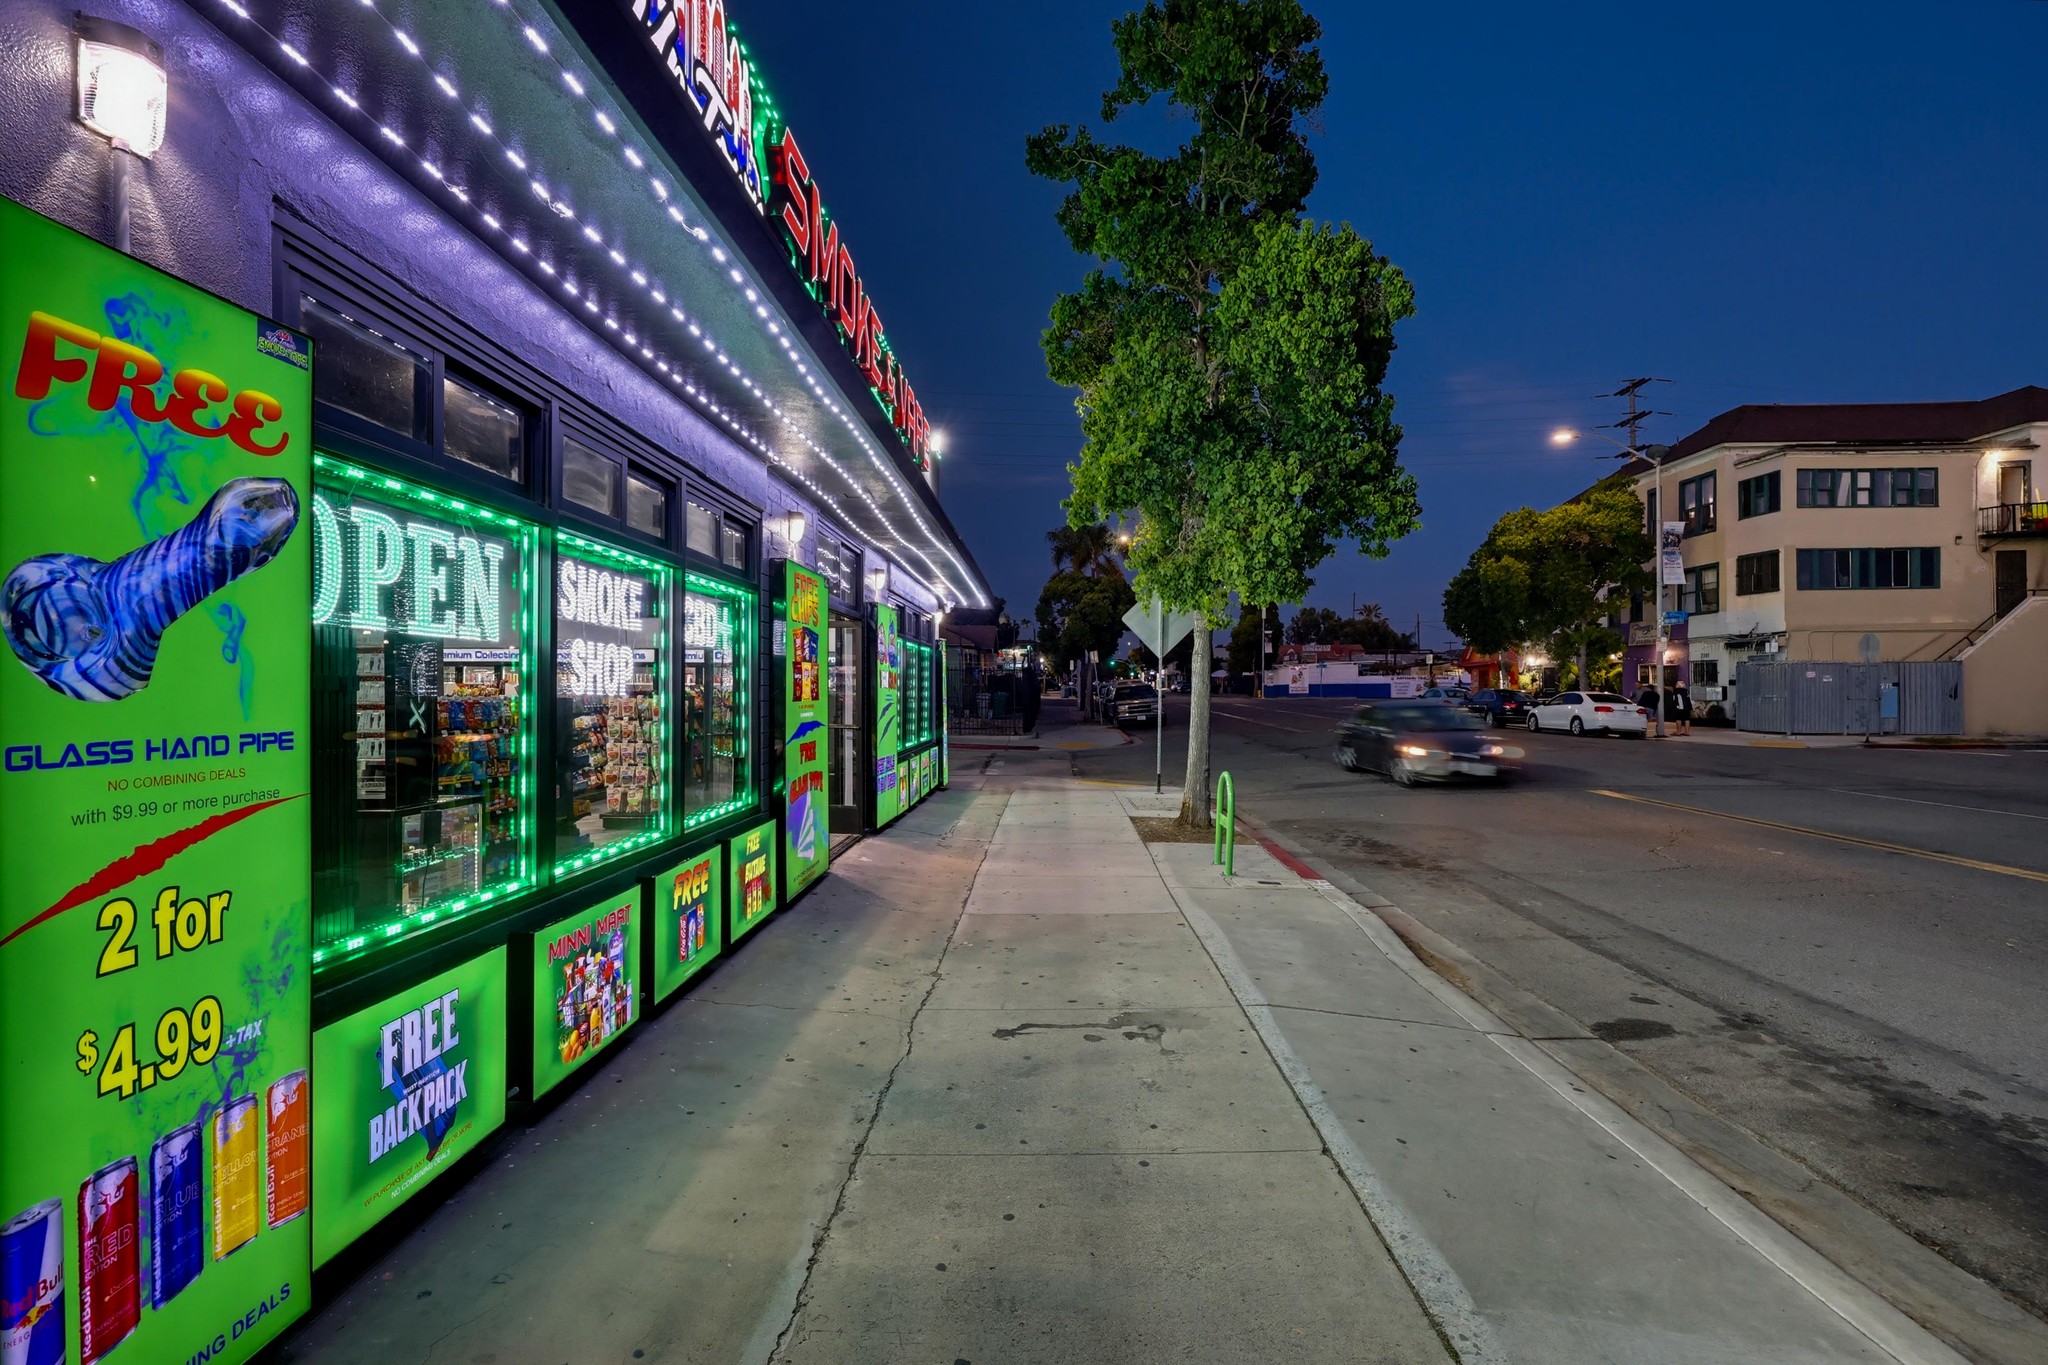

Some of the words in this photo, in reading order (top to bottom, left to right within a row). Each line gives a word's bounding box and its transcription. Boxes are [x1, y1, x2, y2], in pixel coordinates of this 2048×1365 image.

[783, 127, 883, 387] SMOKE
[885, 351, 898, 408] &
[898, 363, 931, 472] VAPE
[15, 311, 289, 456] FREE
[560, 561, 643, 631] SMOKE
[794, 571, 818, 601] FREE
[791, 595, 819, 627] CHIPS
[443, 650, 472, 659] emium
[571, 638, 634, 695] SHOP
[5, 739, 134, 772] GLASS
[145, 734, 230, 762] HAND
[239, 731, 295, 754] PIPE
[107, 779, 129, 792] NO
[132, 771, 206, 789] COMBINING
[209, 767, 246, 781] DEALS
[71, 808, 107, 826] with
[112, 801, 158, 822] $9.99
[162, 801, 178, 814] or
[182, 796, 218, 811] more
[222, 788, 281, 807] purchase
[673, 858, 711, 911] FREE
[95, 897, 139, 978] 2
[152, 886, 233, 960] for
[596, 903, 633, 942] MART
[76, 995, 224, 1101] $4.99
[380, 987, 460, 1091] FREE
[268, 1123, 310, 1151] RANG
[217, 1150, 258, 1181] ELLO
[84, 1223, 135, 1272] RED
[37, 1261, 64, 1301] Bull
[81, 1285, 92, 1320] Bull
[232, 1282, 291, 1341] DEALS
[81, 1321, 92, 1358] Red
